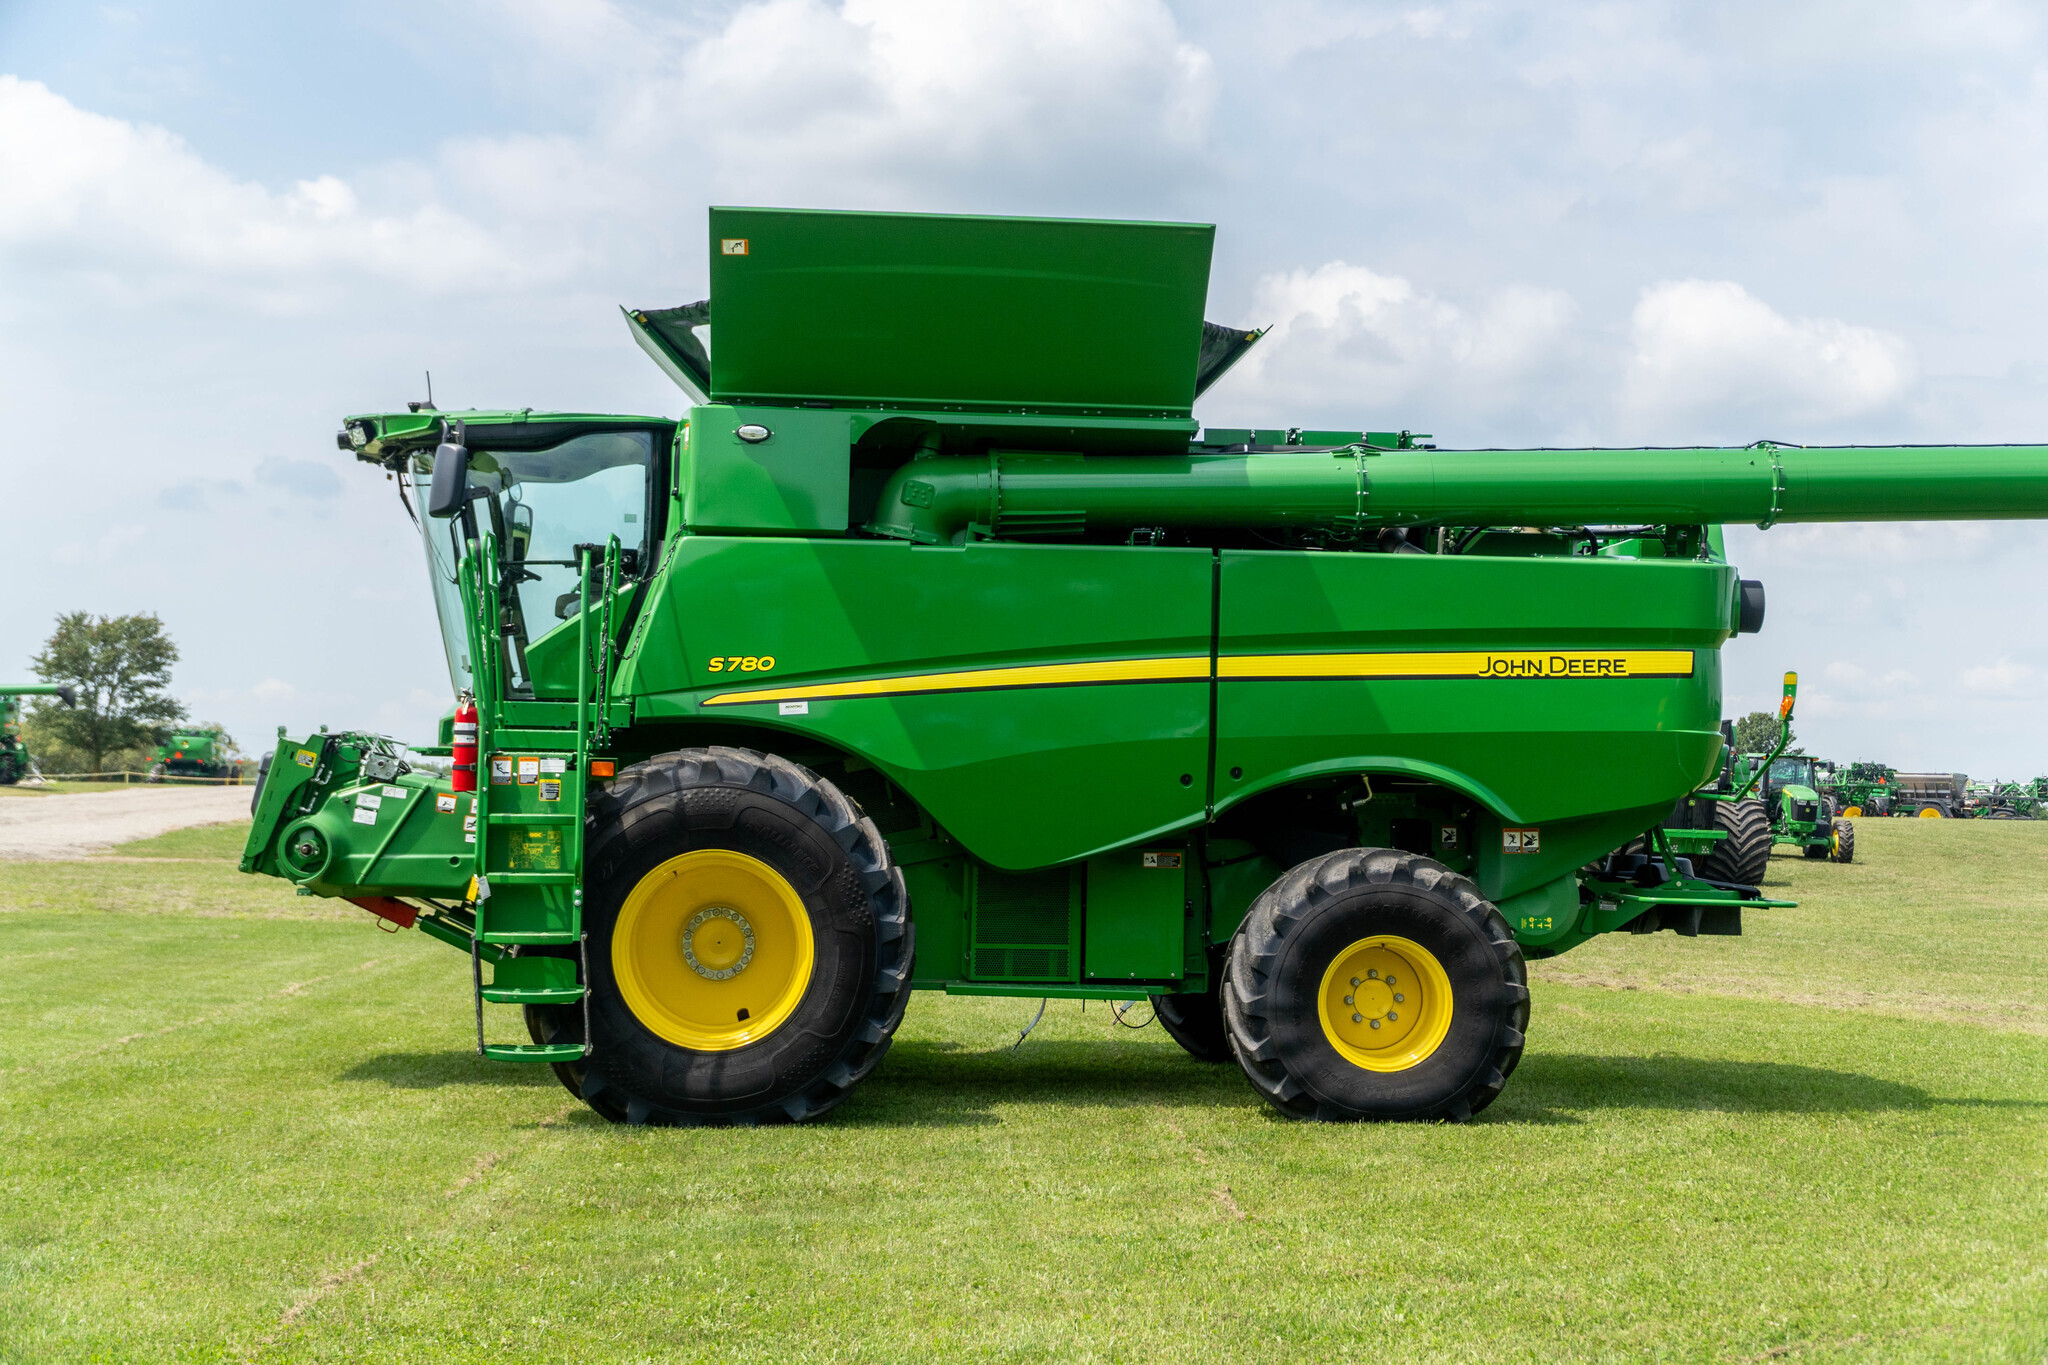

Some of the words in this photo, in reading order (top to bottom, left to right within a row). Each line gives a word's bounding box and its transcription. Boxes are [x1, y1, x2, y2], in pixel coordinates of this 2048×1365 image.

[708, 655, 775, 672] S780
[1479, 656, 1543, 674] JOHN
[1550, 656, 1627, 674] DEERE
